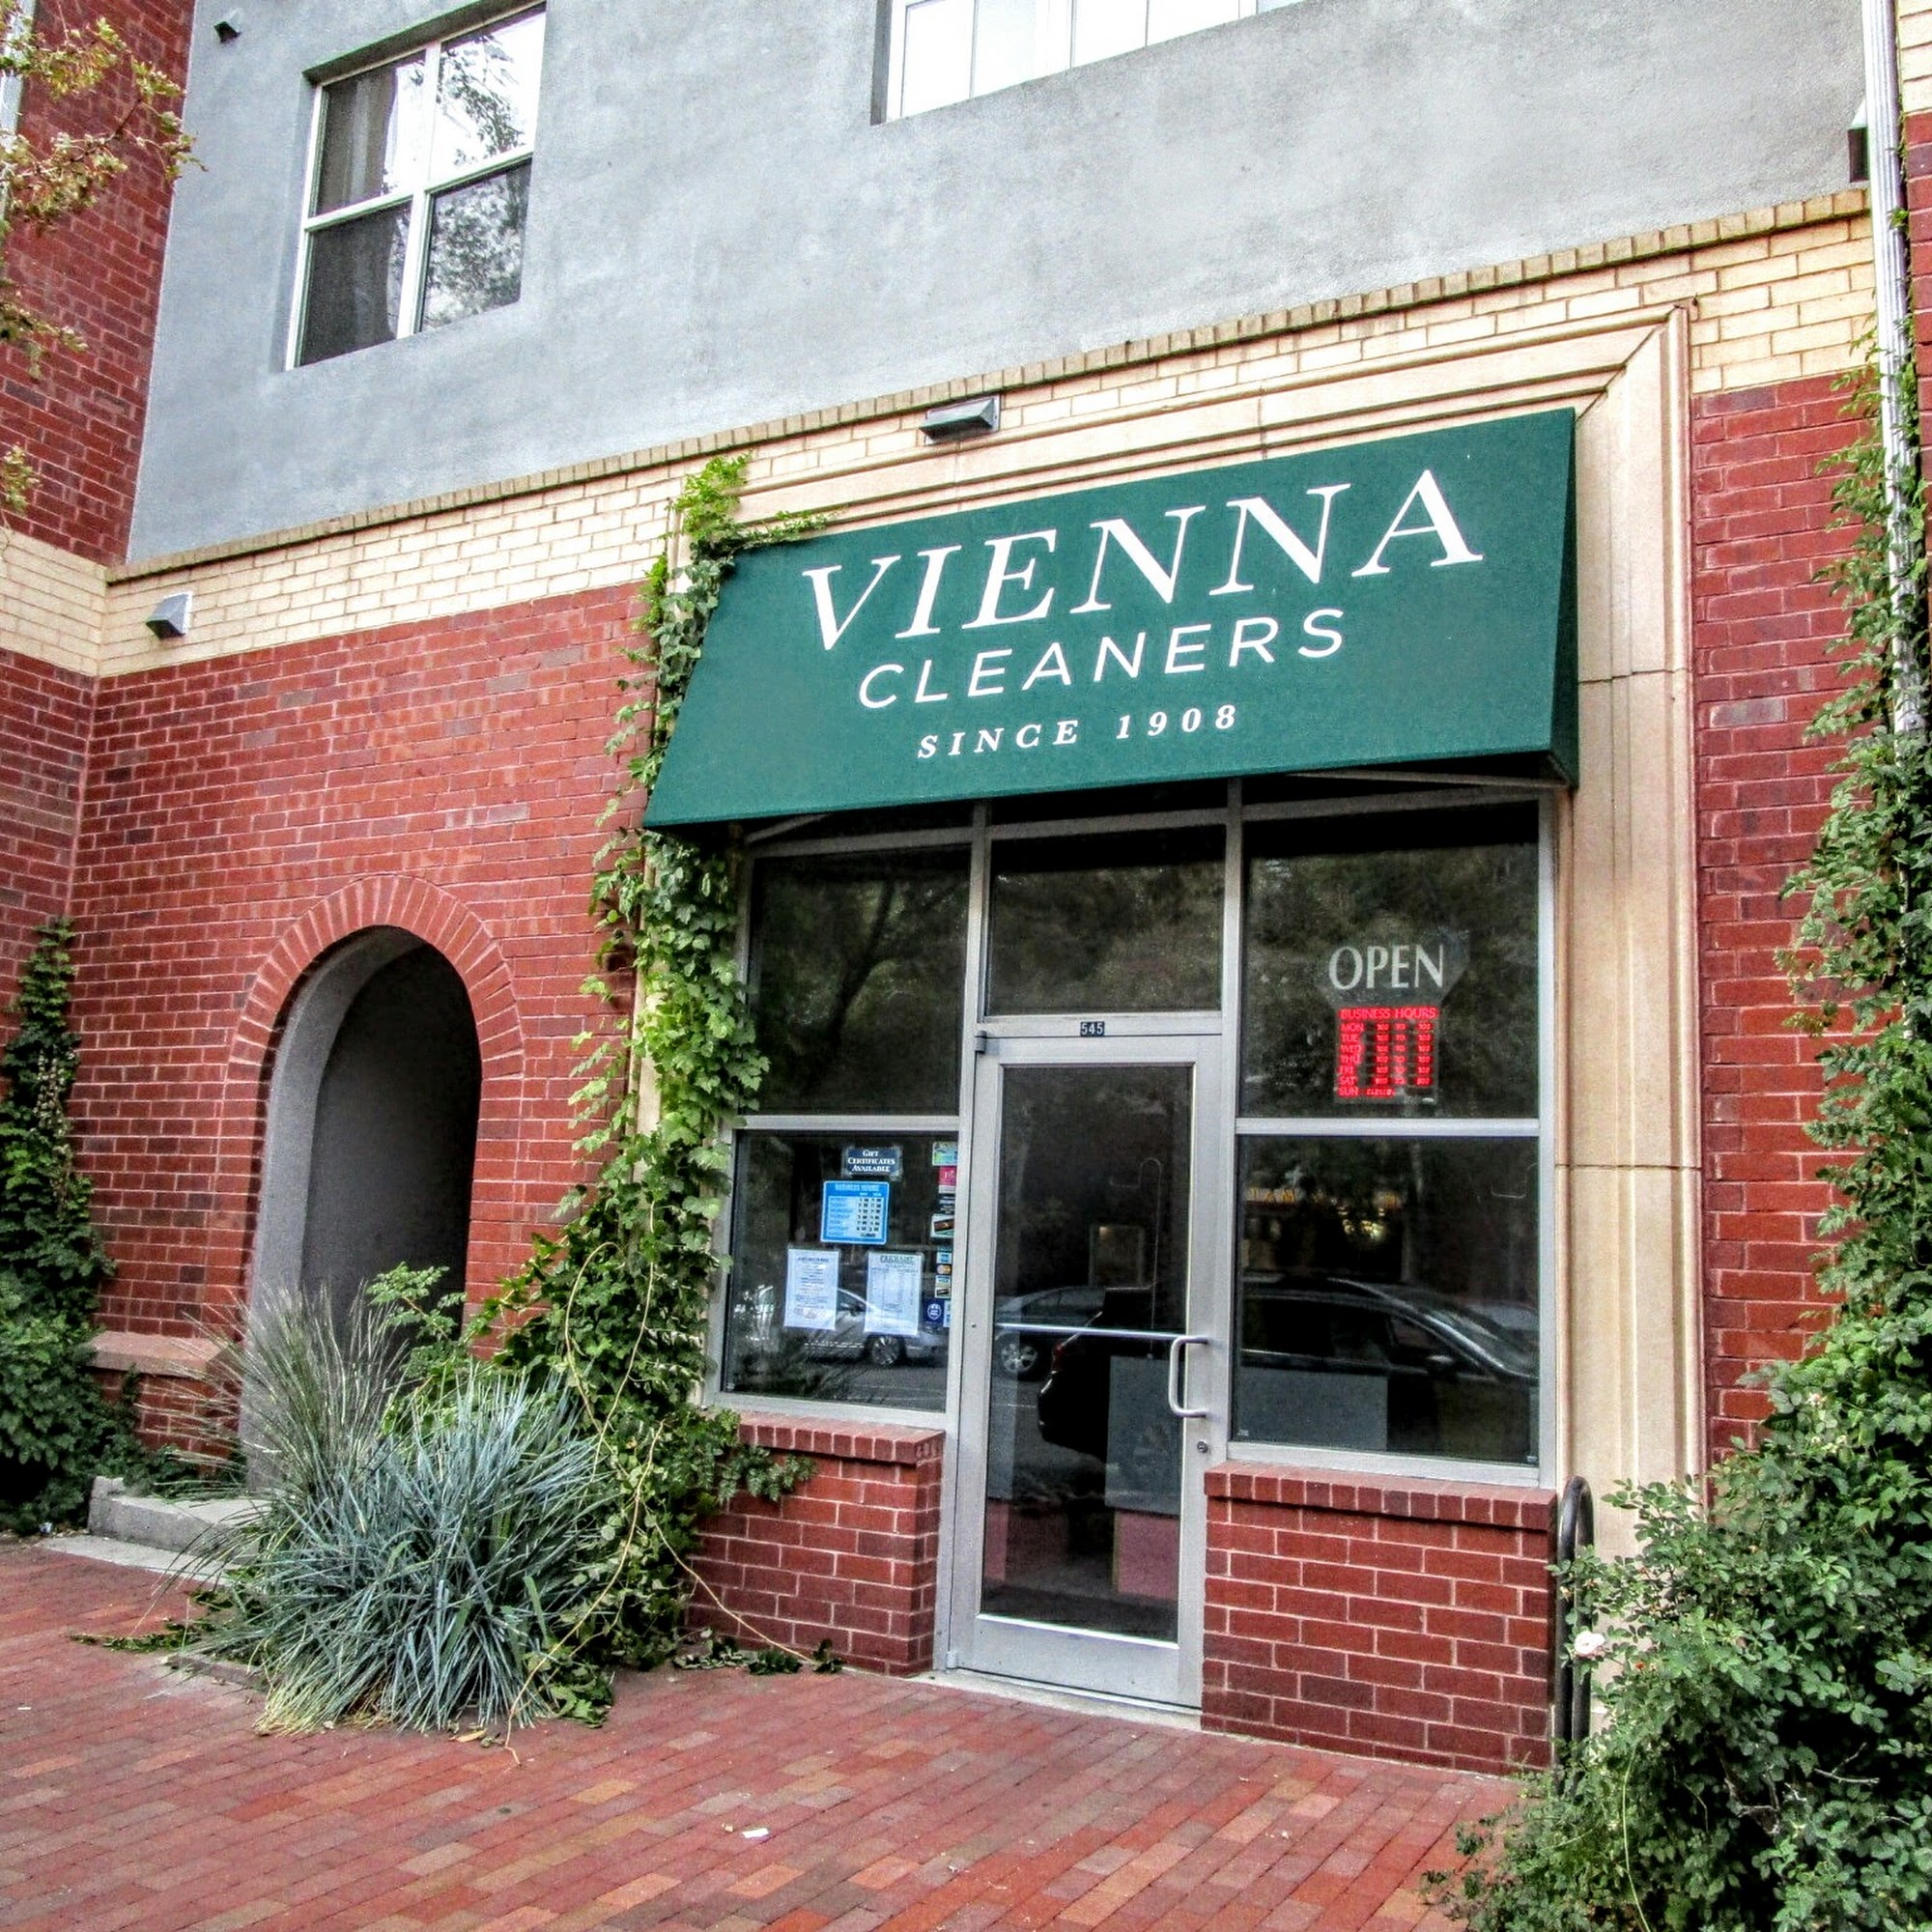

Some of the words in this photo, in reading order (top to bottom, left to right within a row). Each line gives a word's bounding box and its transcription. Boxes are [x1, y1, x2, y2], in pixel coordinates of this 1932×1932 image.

[803, 469, 1483, 650] VIENNA
[860, 609, 1344, 708] CLEANERS
[918, 721, 1079, 758] SINCE
[1117, 704, 1236, 739] 1908
[1328, 944, 1444, 990] OPEN
[1340, 1008, 1391, 1019] BUSINESS
[1394, 1008, 1436, 1018] HOURS
[1081, 1022, 1103, 1035] 545
[1340, 1023, 1364, 1032] MON
[1341, 1034, 1358, 1042] TUE
[1340, 1044, 1362, 1053] WED
[1339, 1076, 1356, 1085] SAT
[1338, 1087, 1358, 1095] SUN
